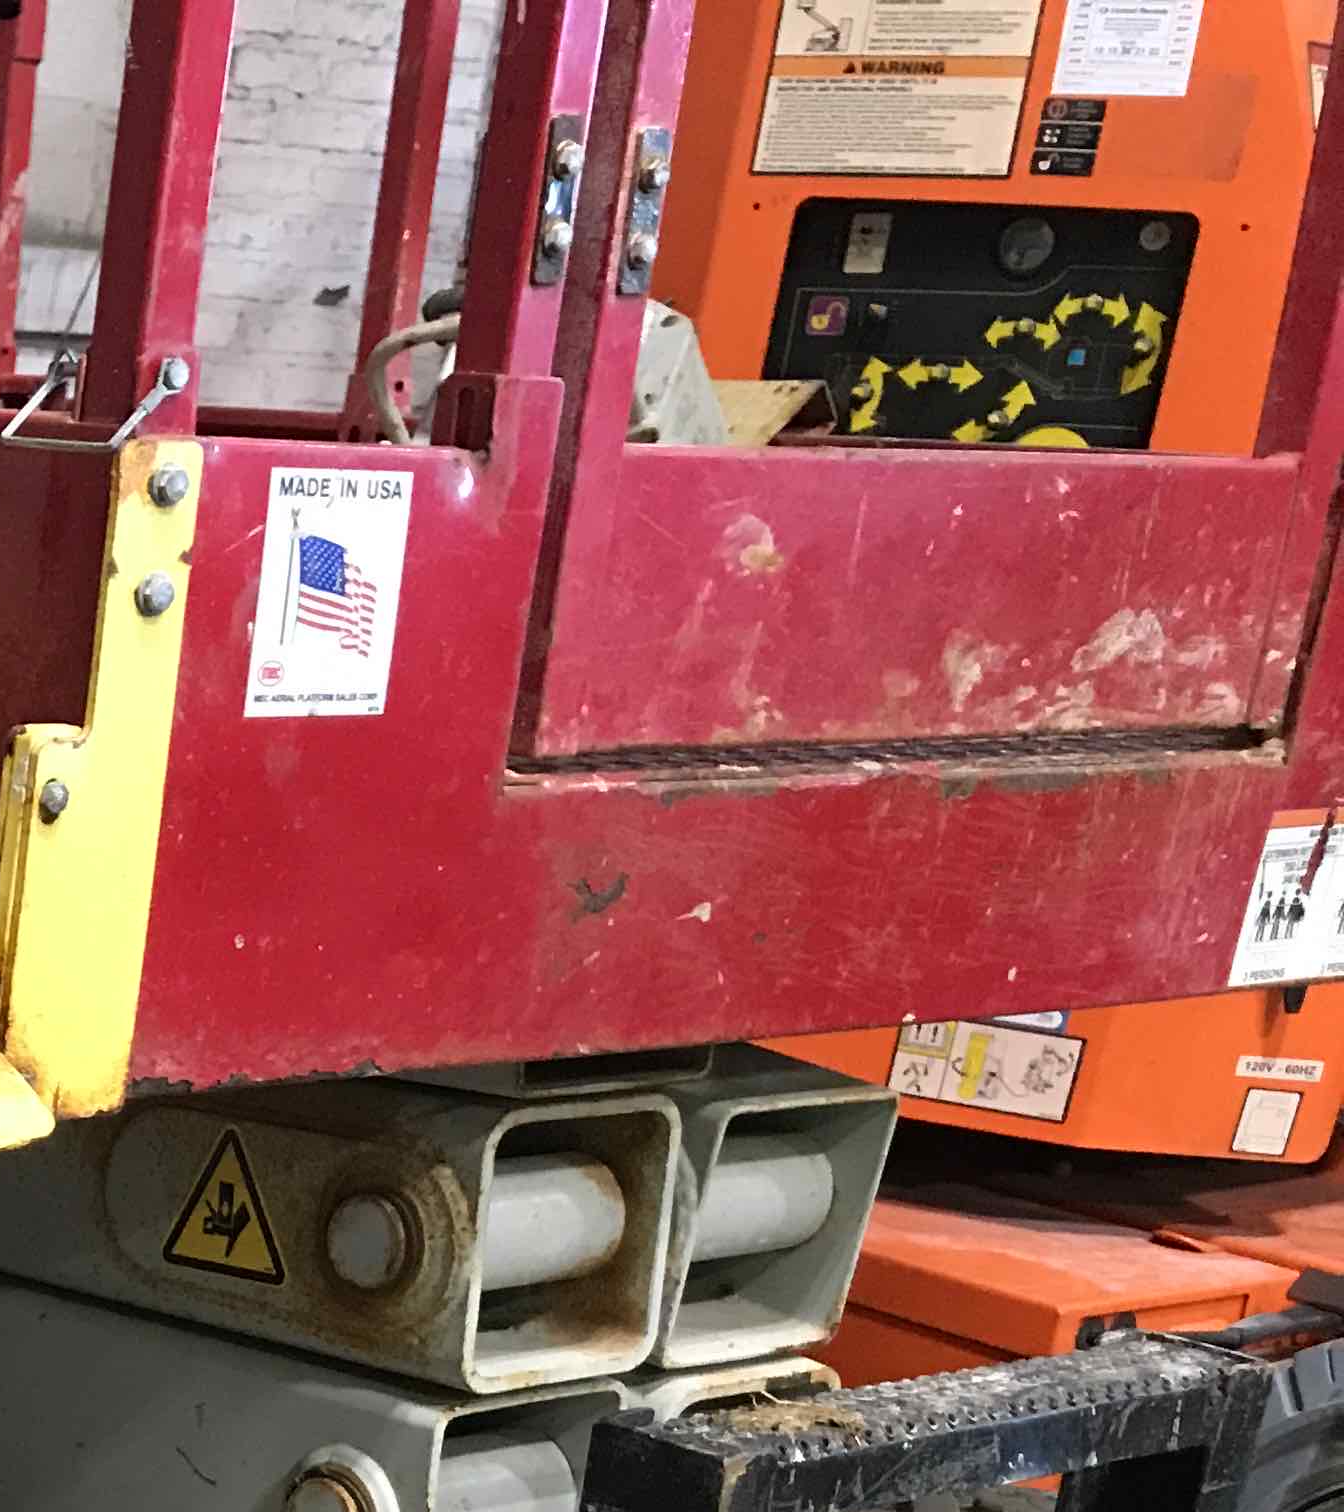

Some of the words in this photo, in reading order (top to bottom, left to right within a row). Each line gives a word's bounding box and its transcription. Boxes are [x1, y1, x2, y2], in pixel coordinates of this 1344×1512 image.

[862, 61, 945, 75] WARNING
[278, 476, 331, 498] MADE
[340, 478, 358, 498] IN
[367, 480, 403, 499] USA
